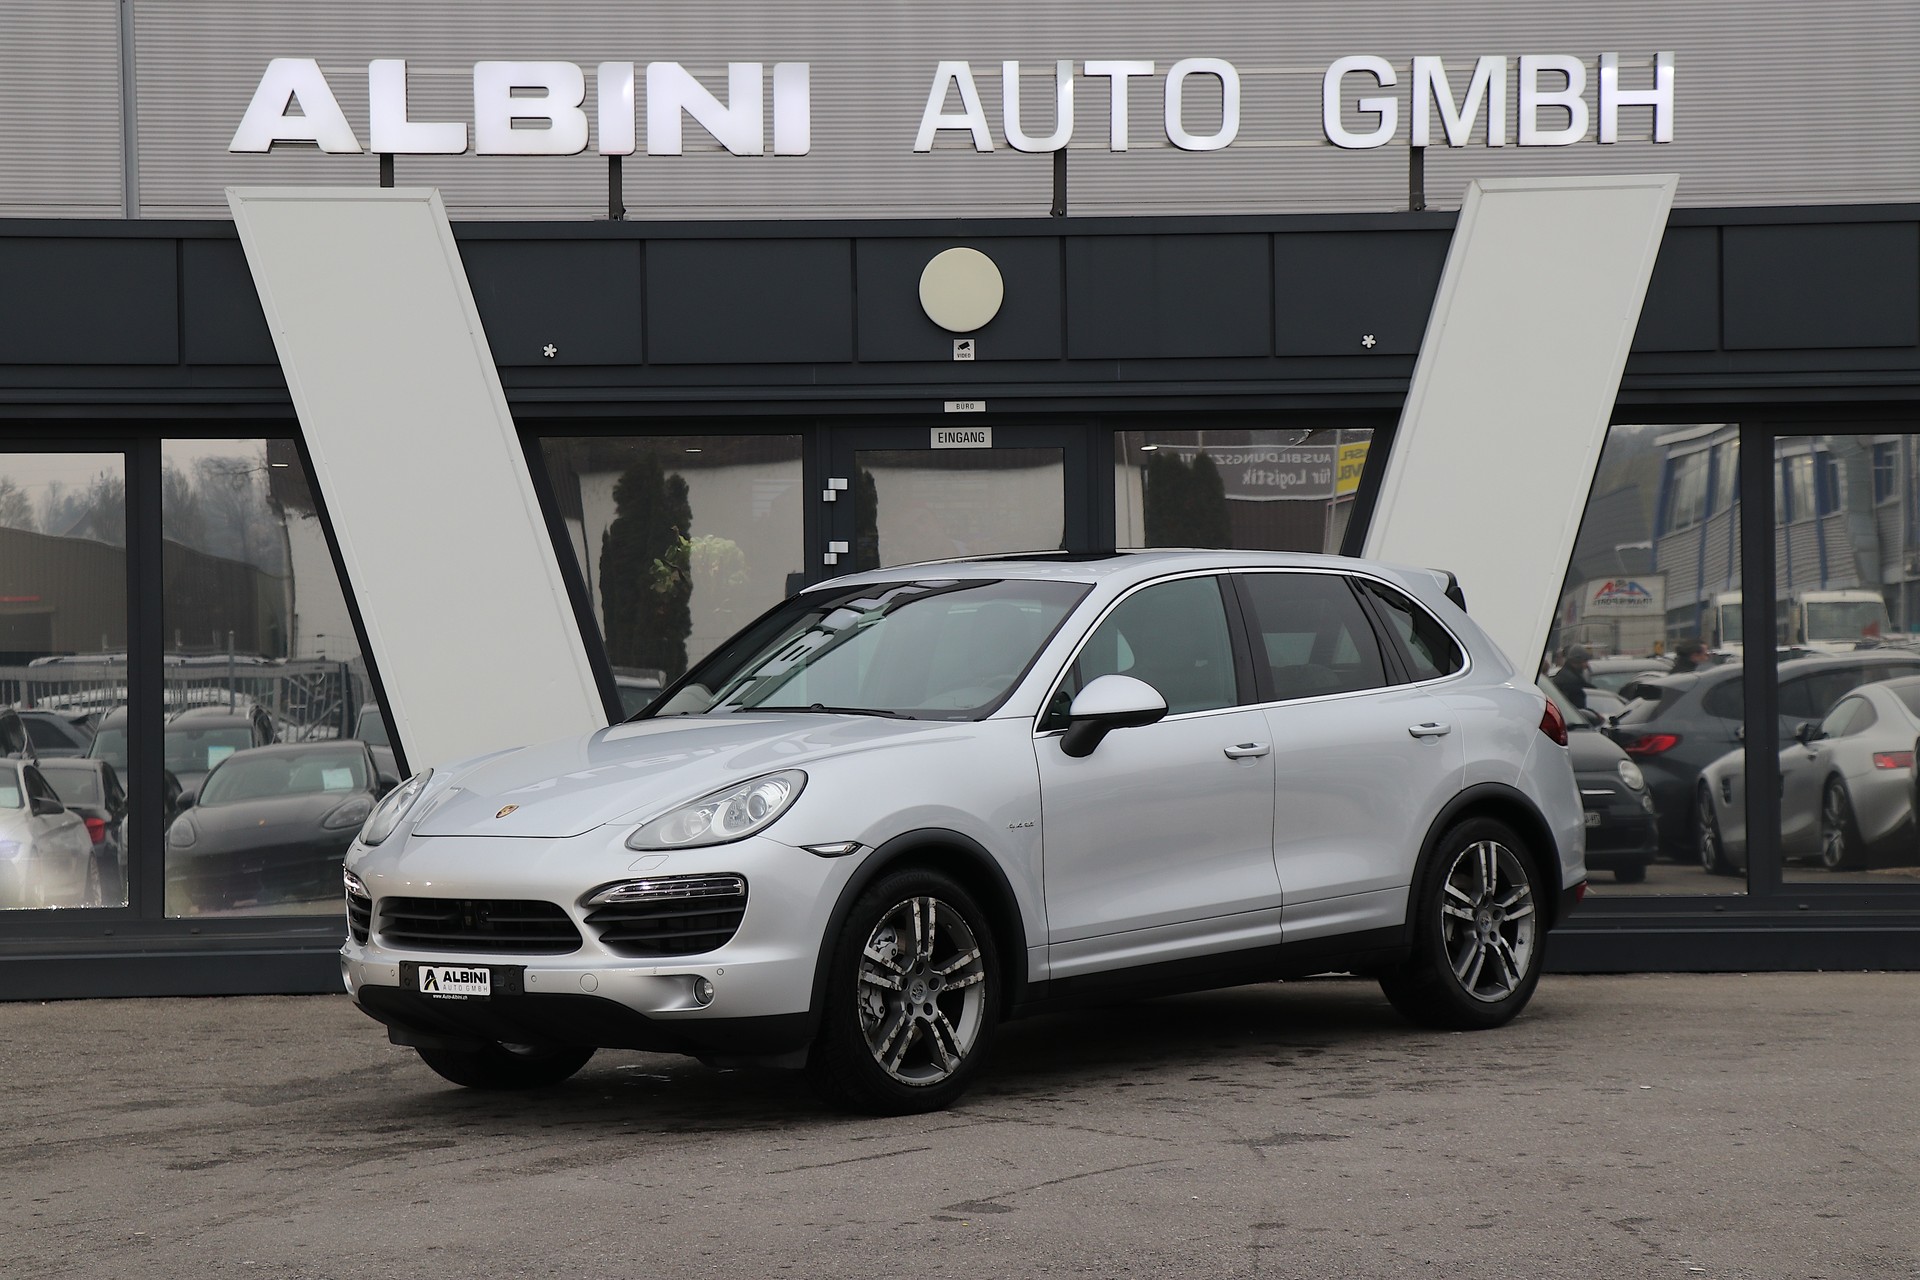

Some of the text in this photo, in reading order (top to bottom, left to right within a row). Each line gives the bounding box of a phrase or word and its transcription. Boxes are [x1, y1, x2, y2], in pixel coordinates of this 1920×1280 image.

[228, 51, 1675, 156] ALBINI AUTO GMBH
[938, 432, 985, 443] EINGANG
[443, 971, 487, 984] ALBINI
